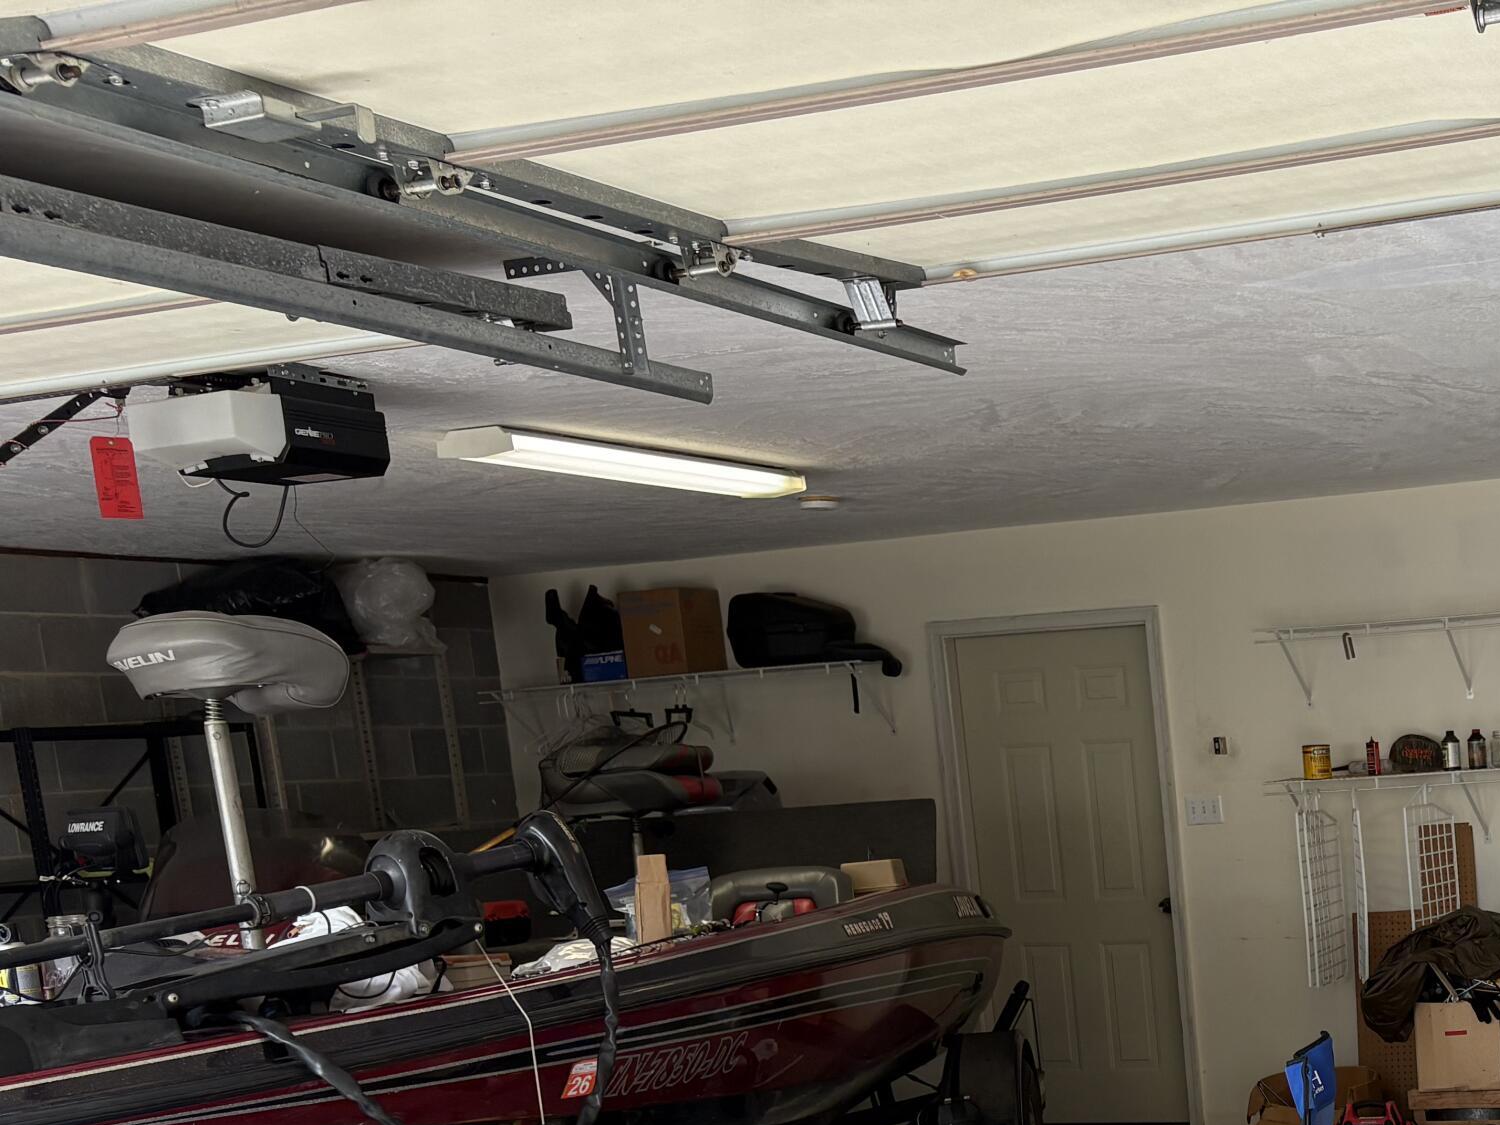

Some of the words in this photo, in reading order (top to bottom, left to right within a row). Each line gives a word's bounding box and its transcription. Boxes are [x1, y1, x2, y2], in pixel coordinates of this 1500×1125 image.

[67, 820, 105, 833] LOWRANCE
[844, 918, 883, 936] RENEGADE
[878, 911, 894, 930] 19
[567, 1074, 593, 1097] 26
